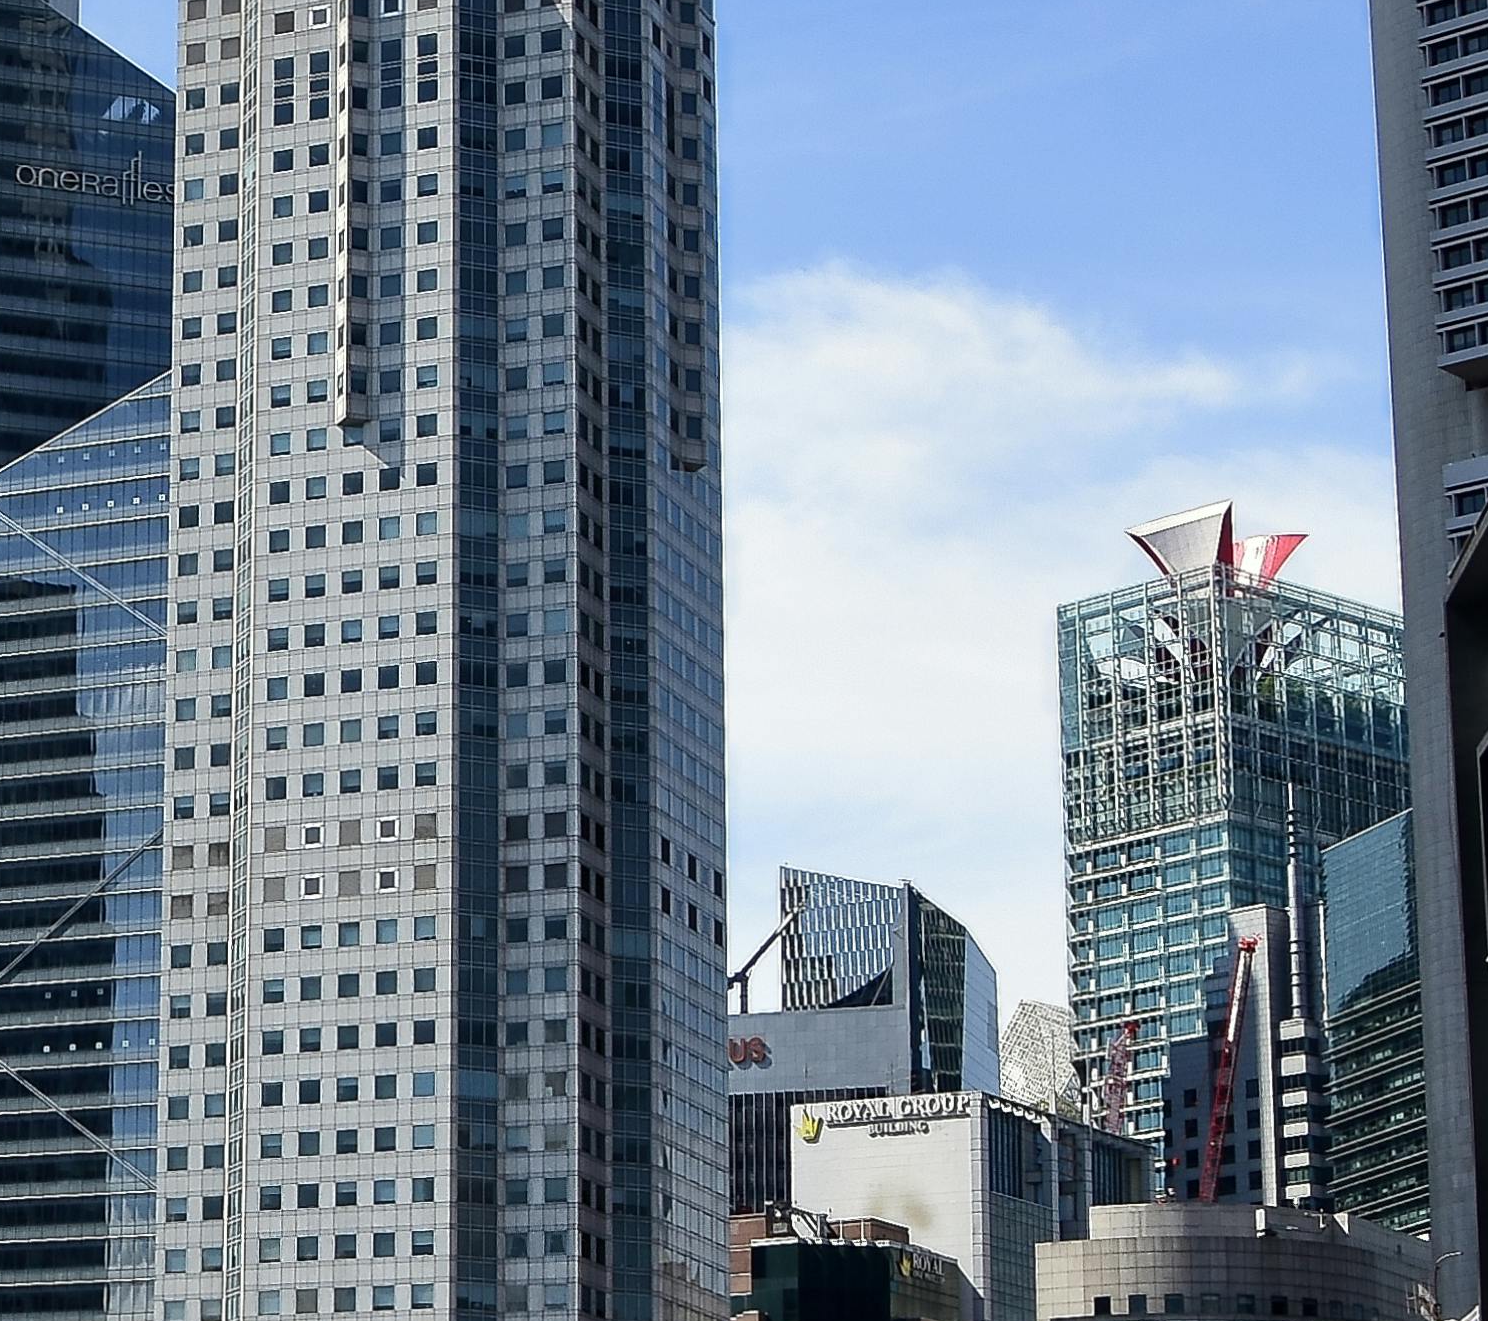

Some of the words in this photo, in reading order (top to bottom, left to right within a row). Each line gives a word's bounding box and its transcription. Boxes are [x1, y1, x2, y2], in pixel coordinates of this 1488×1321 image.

[826, 1099, 894, 1124] ROYAL
[897, 1093, 972, 1118] GROUP
[867, 1119, 930, 1137] BUILDING
[913, 1252, 945, 1276] ROYAL
